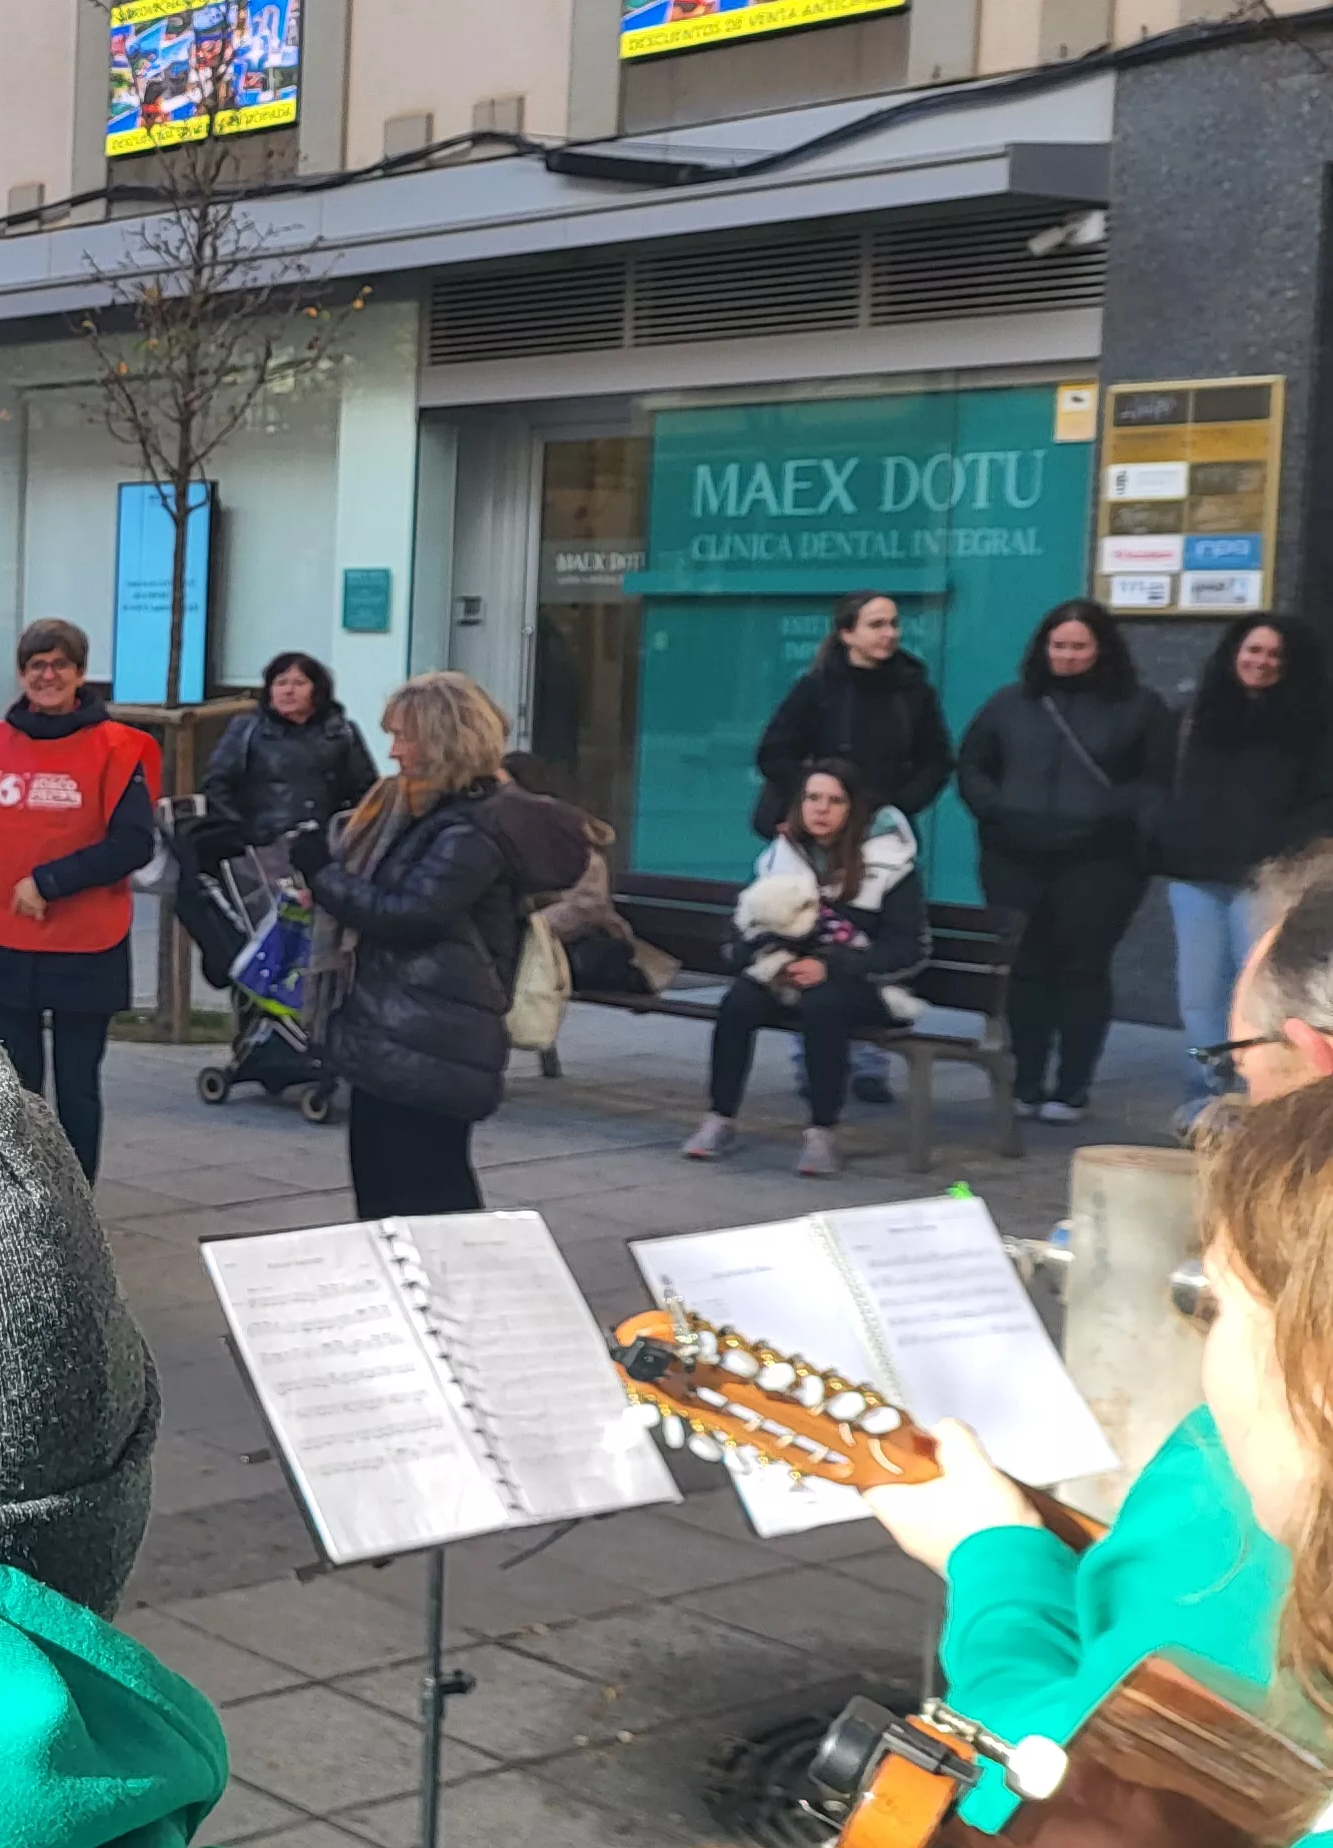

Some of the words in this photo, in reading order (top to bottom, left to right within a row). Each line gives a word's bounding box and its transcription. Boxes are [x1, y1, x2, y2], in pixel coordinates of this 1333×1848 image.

[691, 456, 860, 519] MAEX
[878, 449, 1048, 514] DOTU
[798, 528, 906, 560] DENTAL
[909, 526, 1045, 558] INTEGRAL
